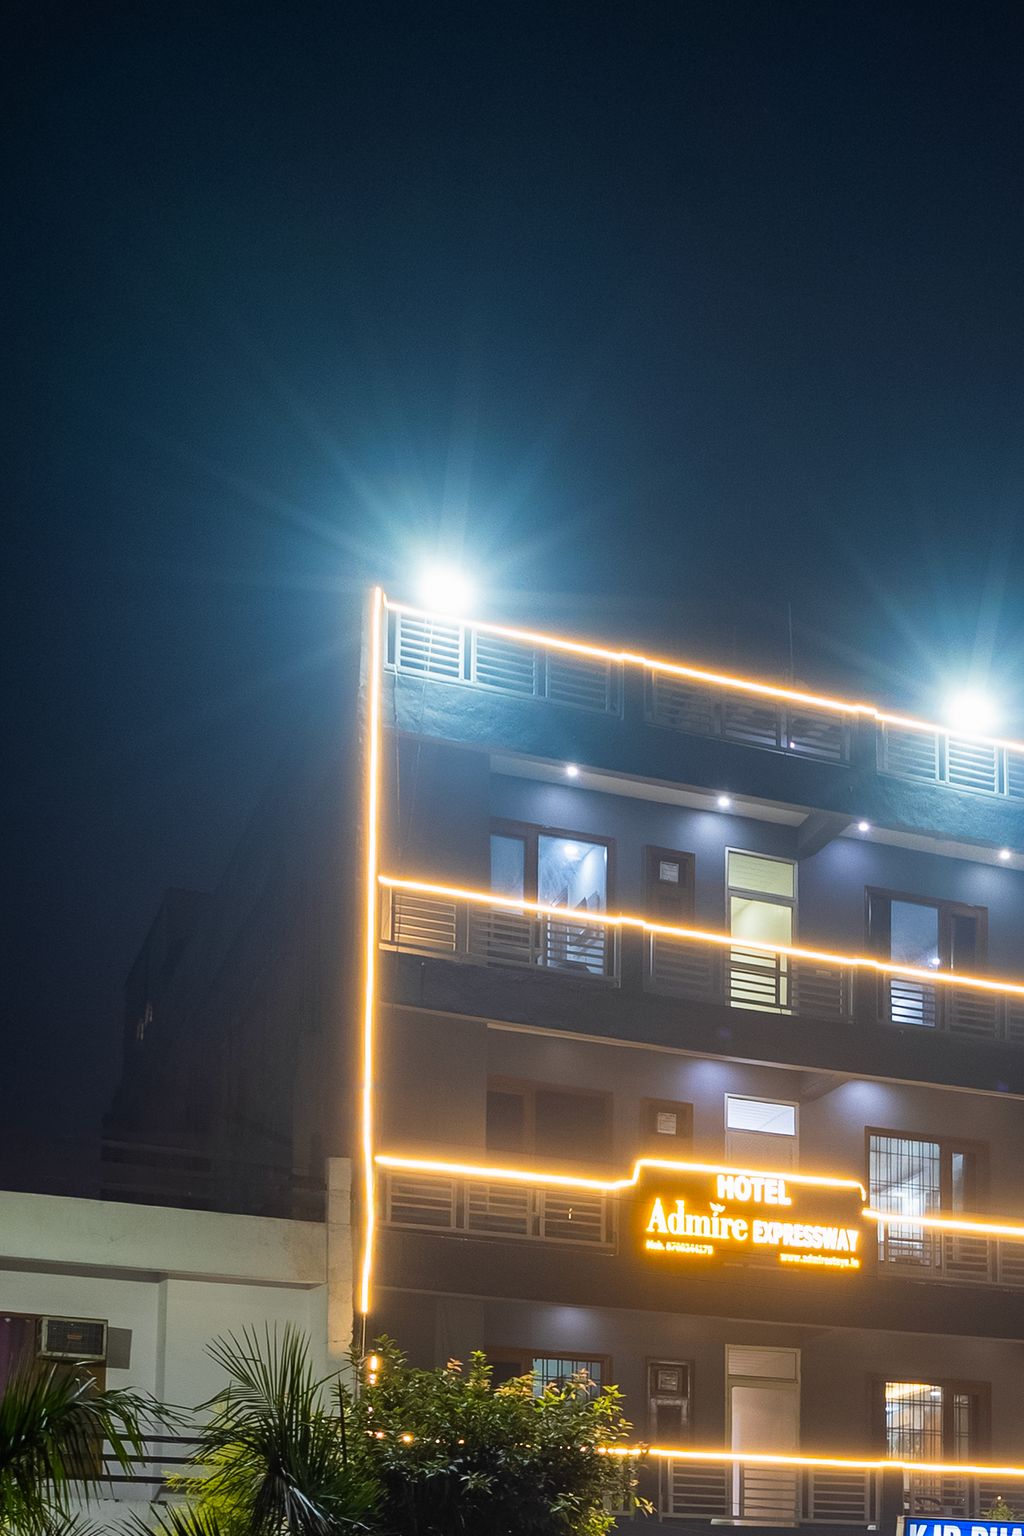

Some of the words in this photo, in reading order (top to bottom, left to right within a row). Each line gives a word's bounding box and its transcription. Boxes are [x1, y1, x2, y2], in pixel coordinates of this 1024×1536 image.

[716, 1174, 792, 1206] HOTEL
[646, 1197, 748, 1240] Admire
[752, 1220, 860, 1252] EXPRESSWAY
